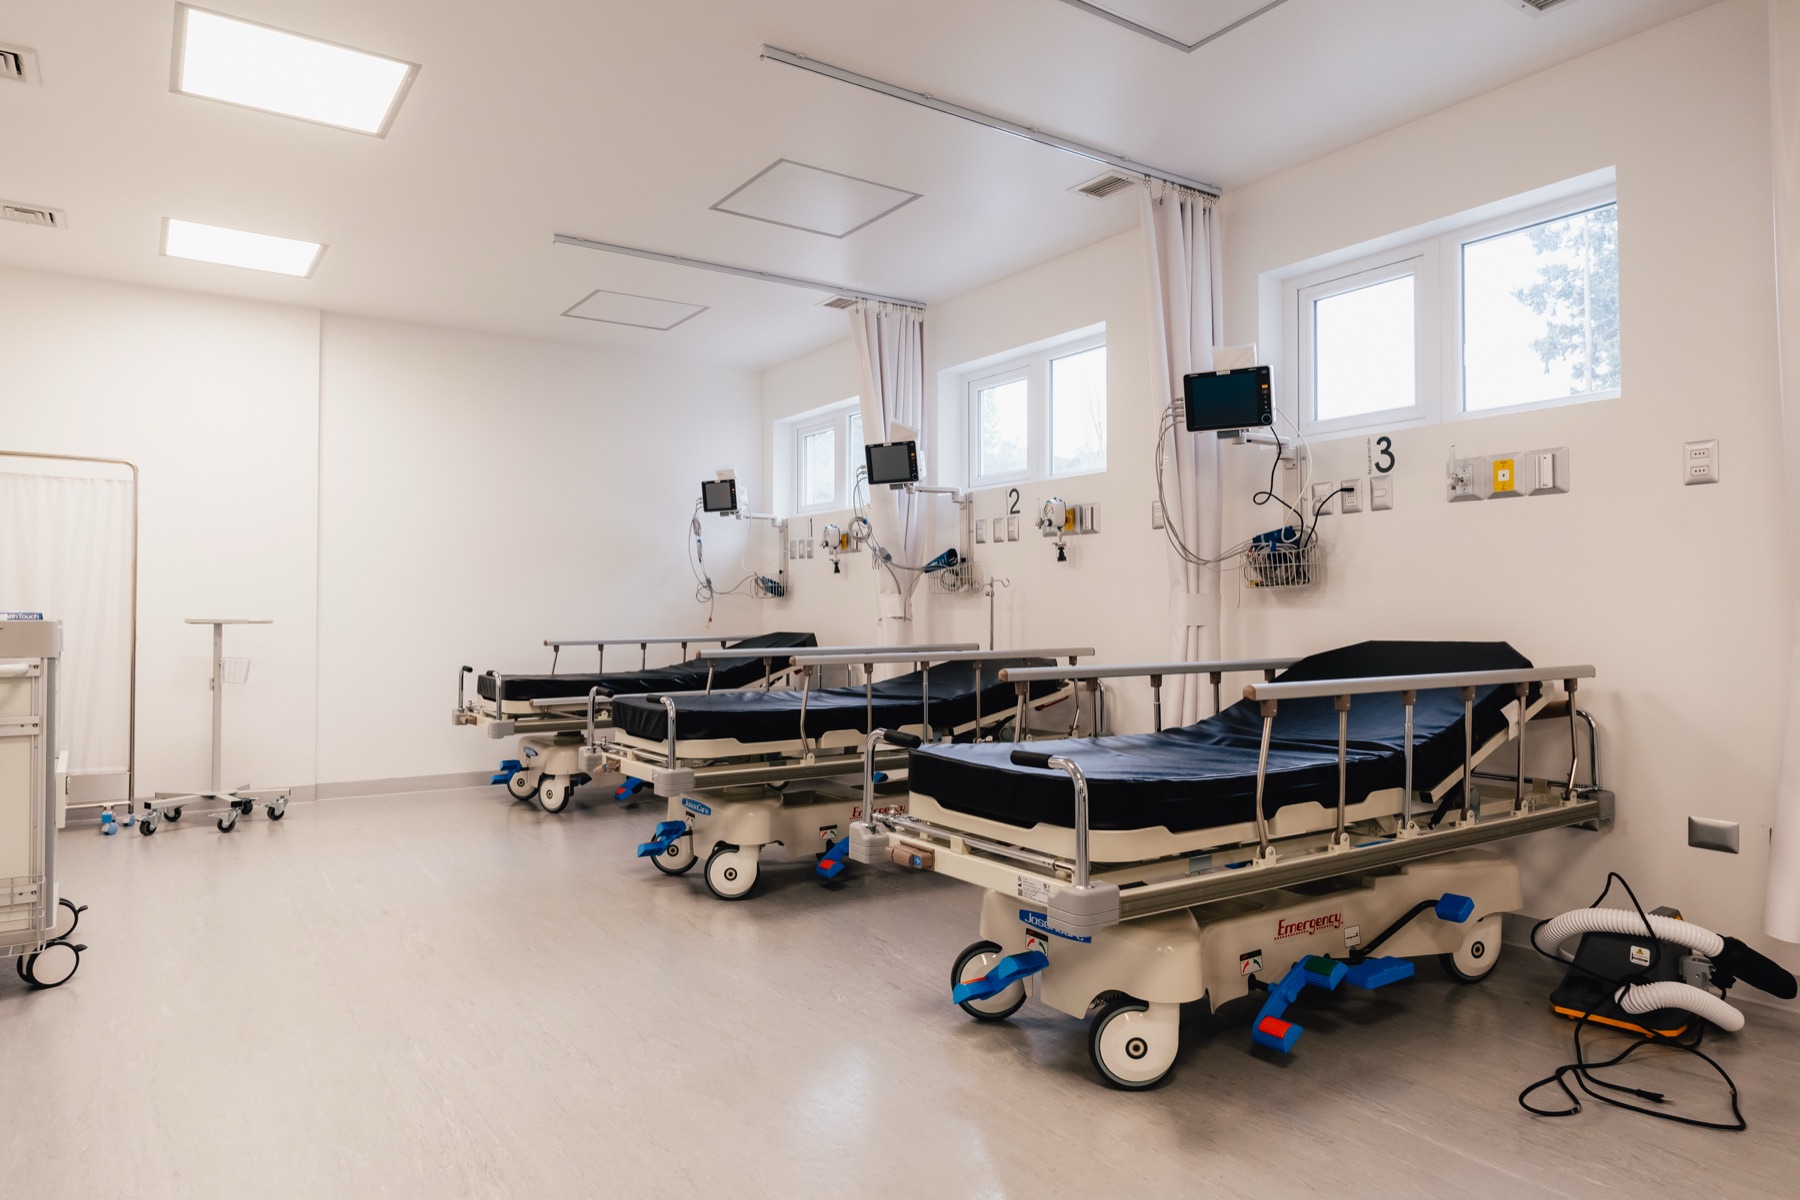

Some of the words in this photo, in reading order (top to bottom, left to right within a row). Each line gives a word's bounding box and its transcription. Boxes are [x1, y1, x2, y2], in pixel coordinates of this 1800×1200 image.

[1374, 436, 1395, 473] 3
[1009, 488, 1020, 514] 2
[1277, 913, 1342, 936] Emergency
